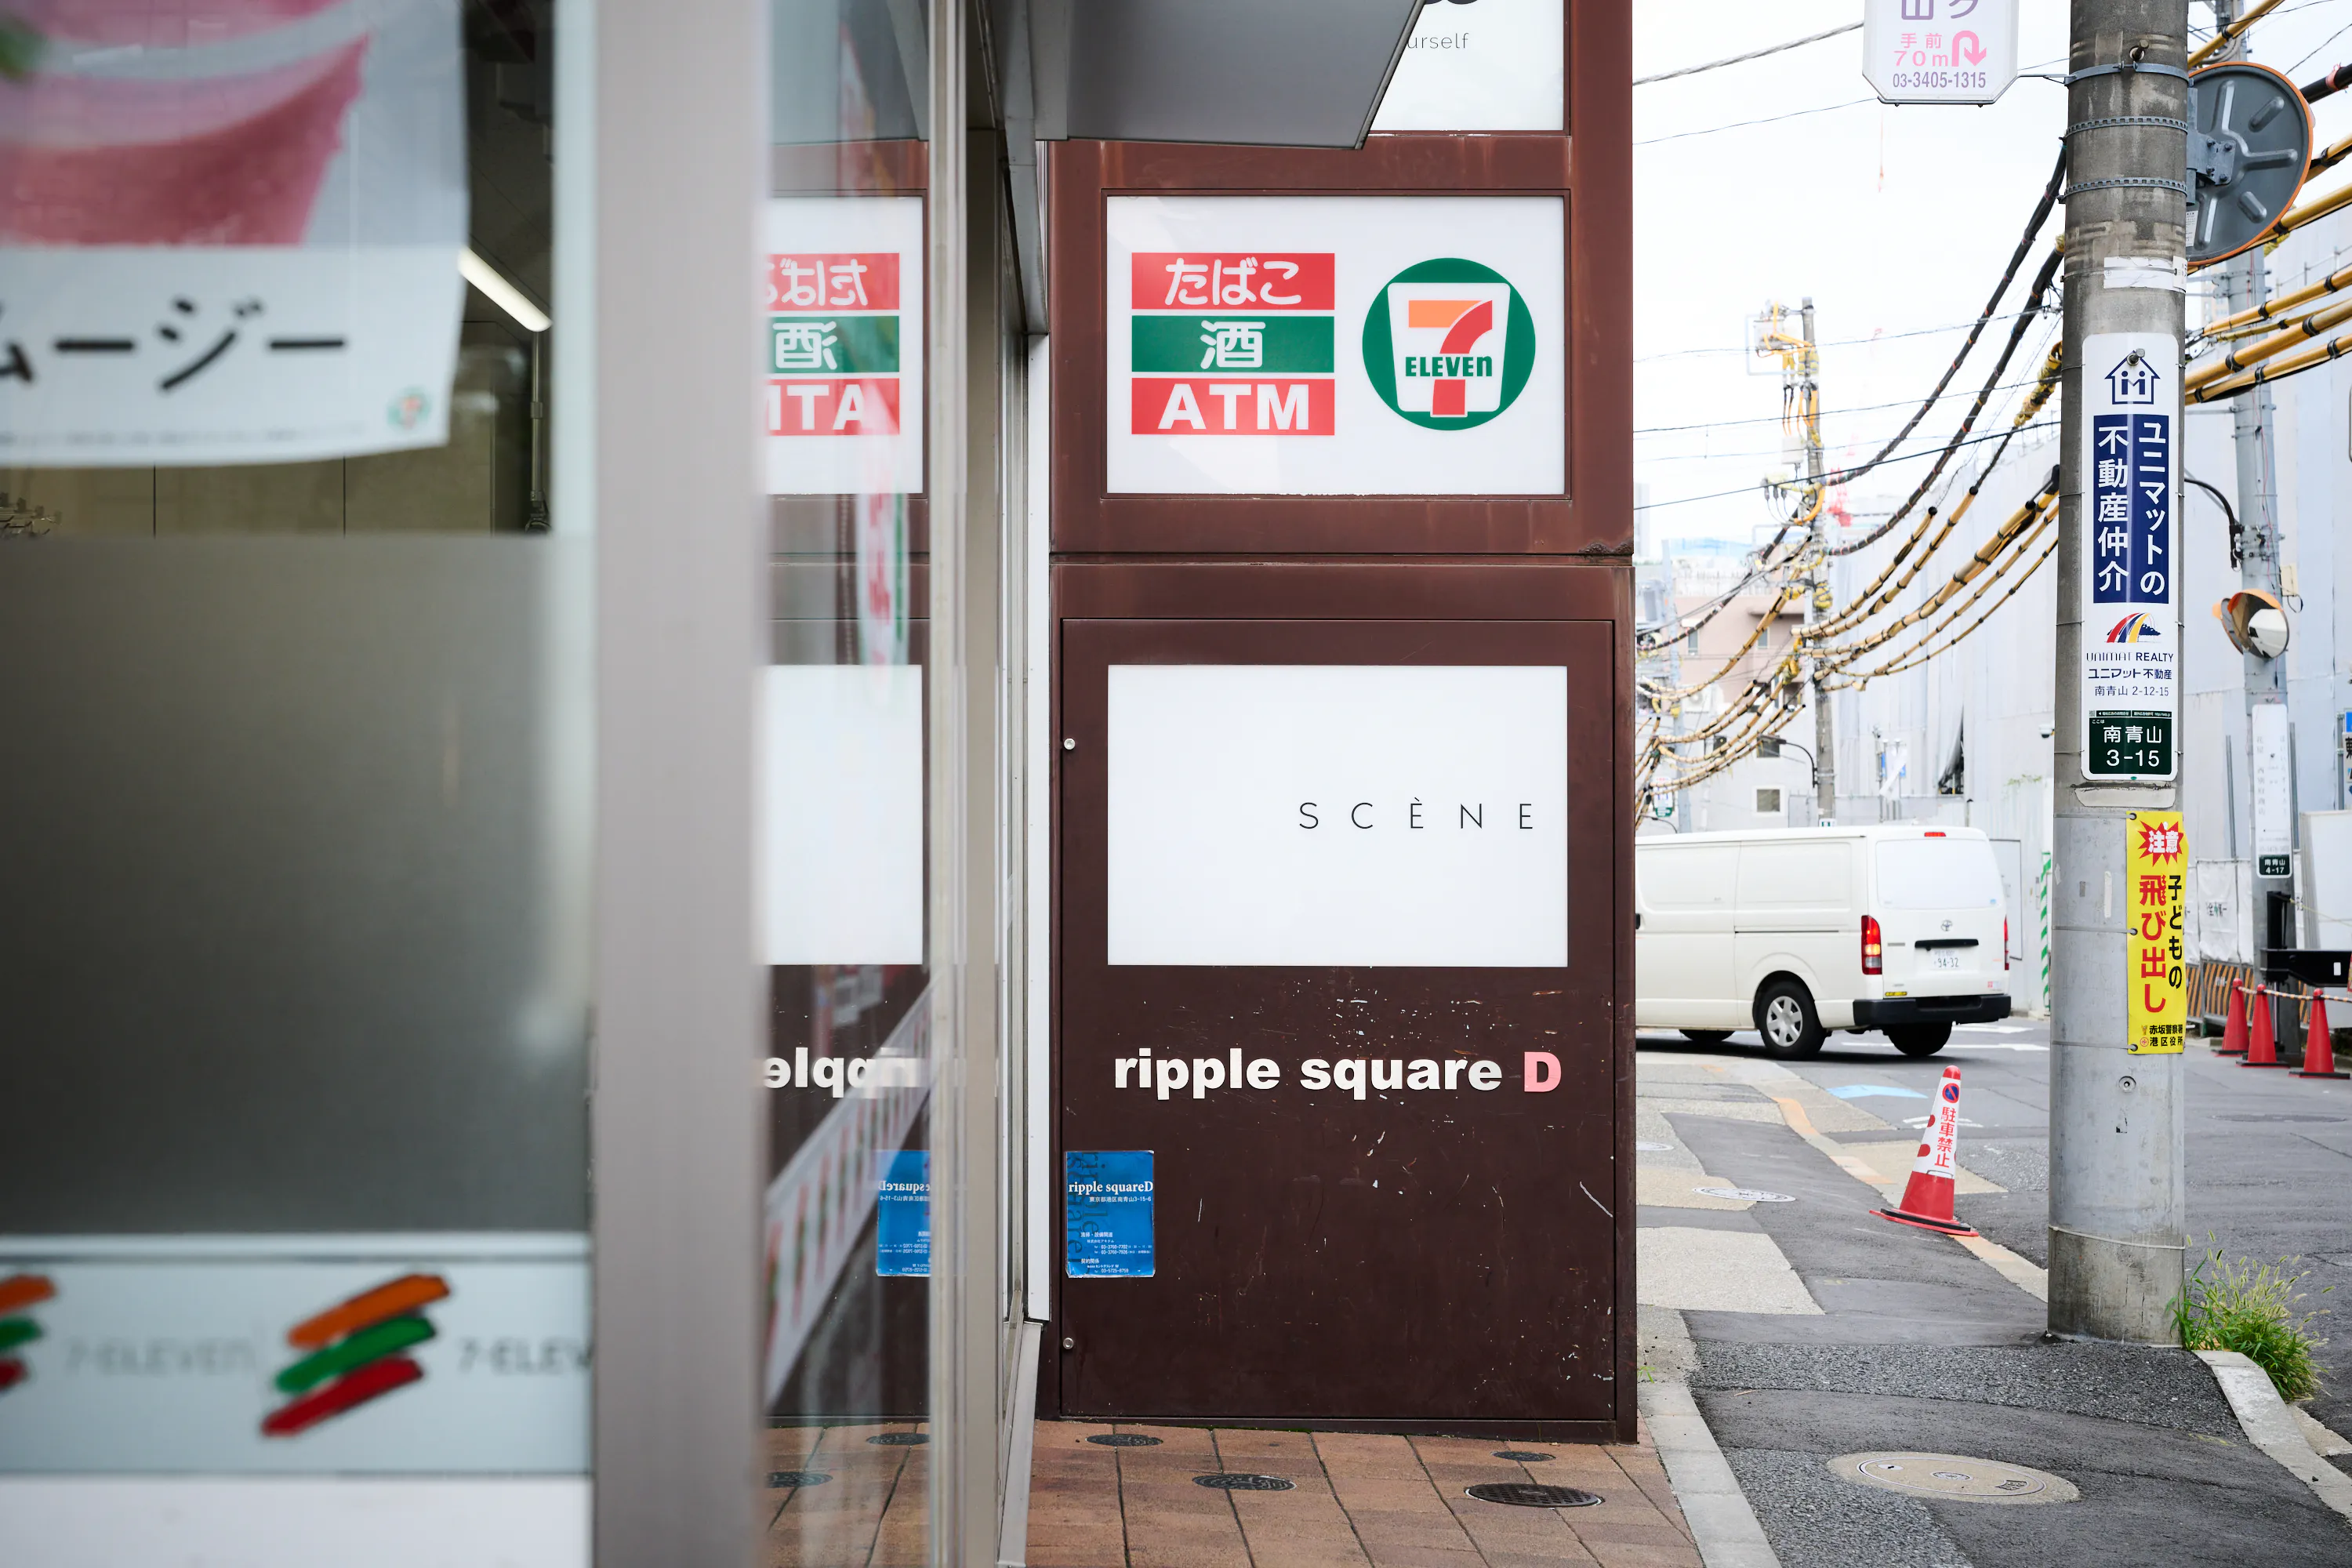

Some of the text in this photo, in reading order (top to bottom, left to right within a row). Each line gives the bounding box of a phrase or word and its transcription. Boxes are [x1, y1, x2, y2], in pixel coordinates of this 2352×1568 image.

[1407, 33, 1469, 49] urself
[1900, 33, 1942, 49] 手前
[1893, 51, 1948, 67] 70m
[1893, 71, 1986, 89] 03-3405-1315
[1165, 256, 1301, 305] たばこ
[1200, 320, 1265, 369] 酒
[1158, 384, 1309, 430] ATM
[2098, 426, 2129, 592] 不動産仲介
[2139, 422, 2166, 596] ユニマットの
[2136, 652, 2173, 662] REALTY
[2095, 685, 2169, 696] 南青山 2-12-15
[2103, 725, 2162, 743] 南青山
[2106, 750, 2160, 767] 3-15
[1299, 797, 1534, 829] SCÈNE
[2148, 830, 2179, 853] 注意
[2168, 875, 2183, 989] 子どもの
[2139, 874, 2167, 1013] 飛び出し
[2149, 1024, 2183, 1035] 赤坂警察署
[2150, 1036, 2183, 1047] 港区役所
[1115, 1047, 1562, 1101] ripple square D
[1934, 1106, 1957, 1169] 駐車禁止
[1069, 1181, 1153, 1196] ripple squareD
